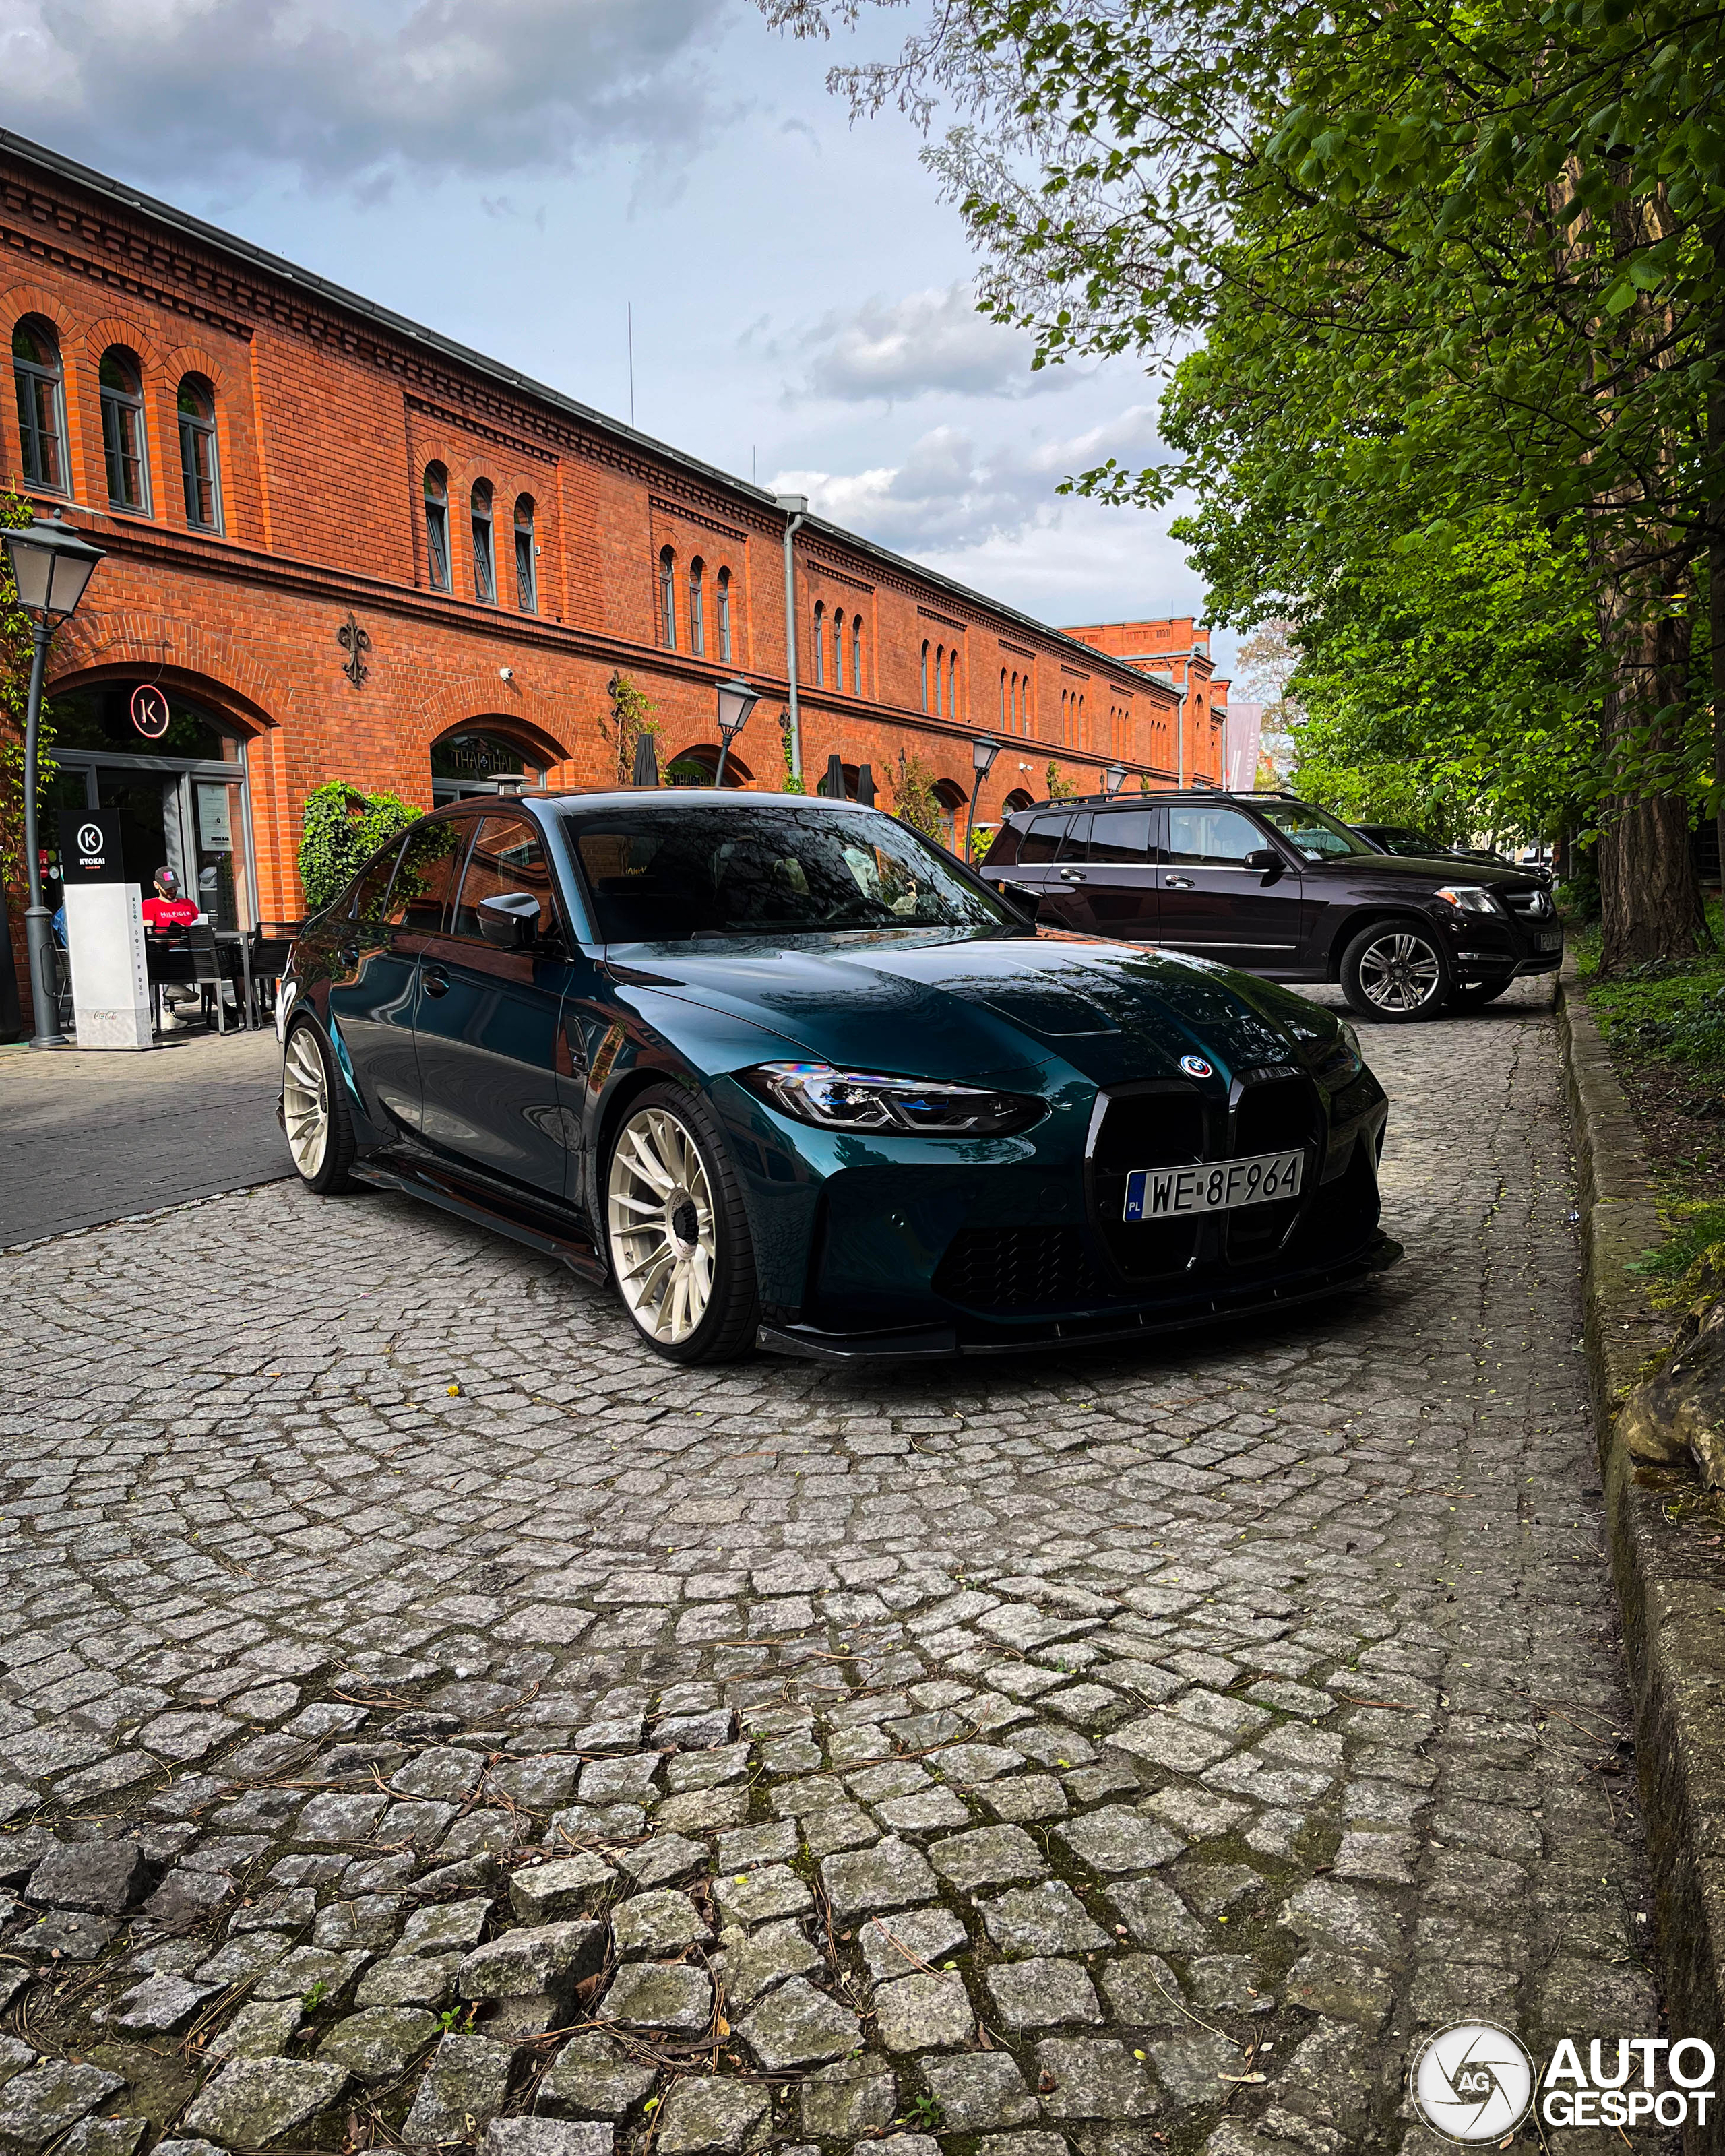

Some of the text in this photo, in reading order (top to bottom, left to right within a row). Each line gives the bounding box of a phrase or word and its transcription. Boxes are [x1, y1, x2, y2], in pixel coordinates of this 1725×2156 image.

[140, 699, 158, 723] K
[452, 749, 512, 772] THAI THAI
[1246, 732, 1255, 776] KOSZARY
[84, 831, 96, 847] K
[79, 858, 105, 866] KYOKAI
[1152, 1155, 1298, 1213] WE 8F964
[1129, 1202, 1141, 1212] PL
